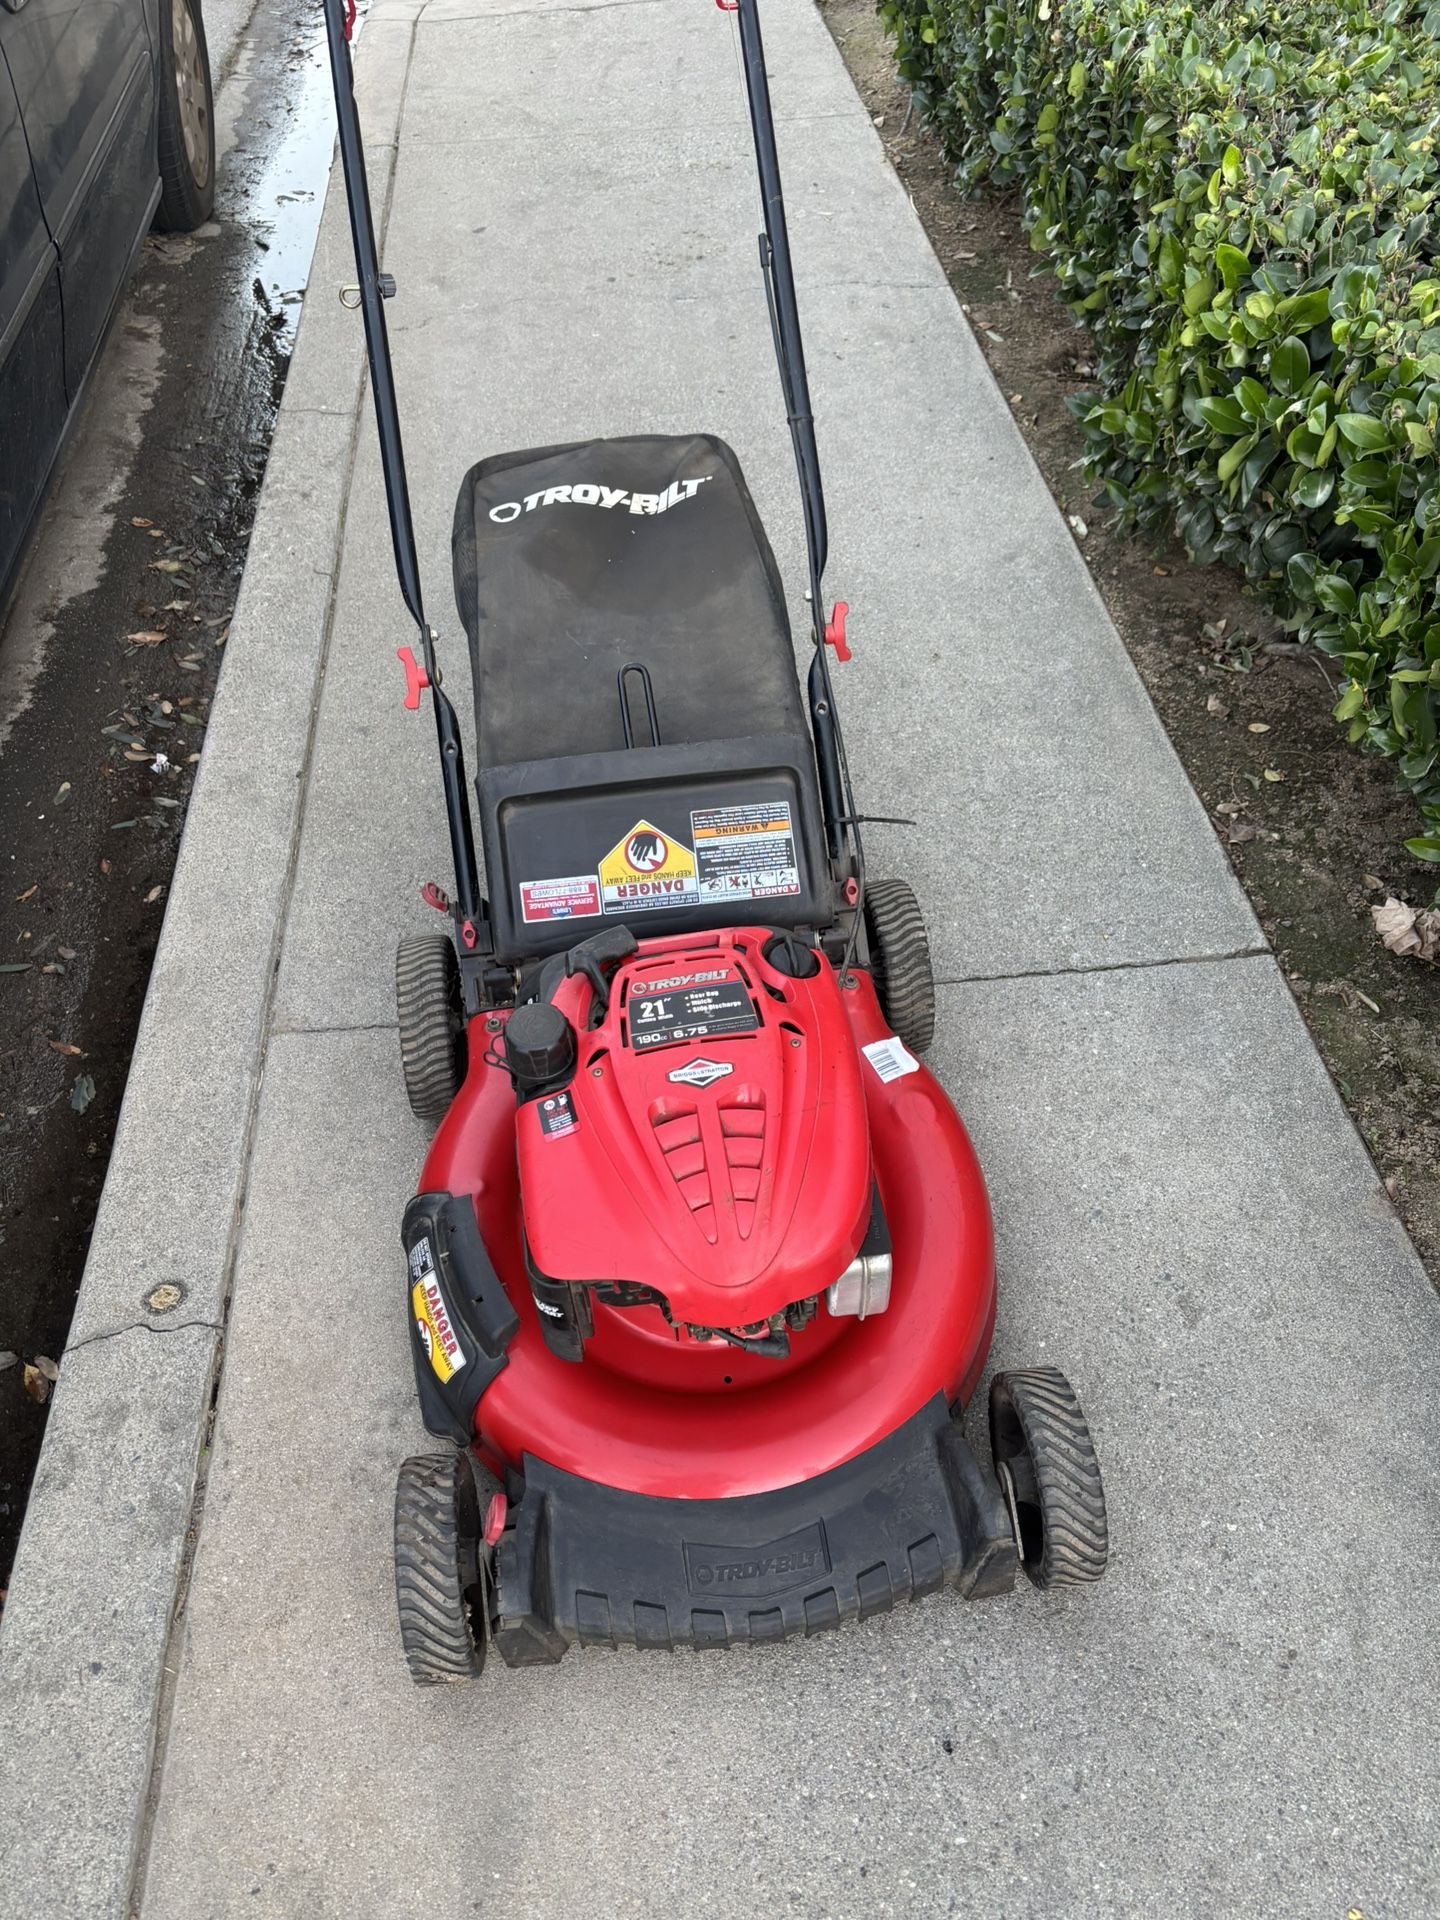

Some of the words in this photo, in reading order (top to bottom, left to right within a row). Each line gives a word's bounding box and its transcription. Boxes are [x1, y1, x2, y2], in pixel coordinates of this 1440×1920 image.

[523, 478, 705, 515] TROY-BILT
[716, 825, 758, 834] WARNING
[605, 877, 624, 885] AWAY
[625, 875, 640, 883] FEET
[654, 871, 675, 880] HANDS
[616, 879, 684, 898] DANGER
[754, 886, 789, 895] DANGER
[529, 900, 566, 910] ADVANTAGE
[568, 897, 594, 905] SERVICE
[648, 969, 729, 991] TROY-BILT
[673, 1026, 708, 1038] 6.75
[427, 1285, 457, 1357] DANGER
[434, 1334, 444, 1351] FEET
[441, 1352, 454, 1371] AWAY
[716, 1551, 817, 1582] TROY-BILT
